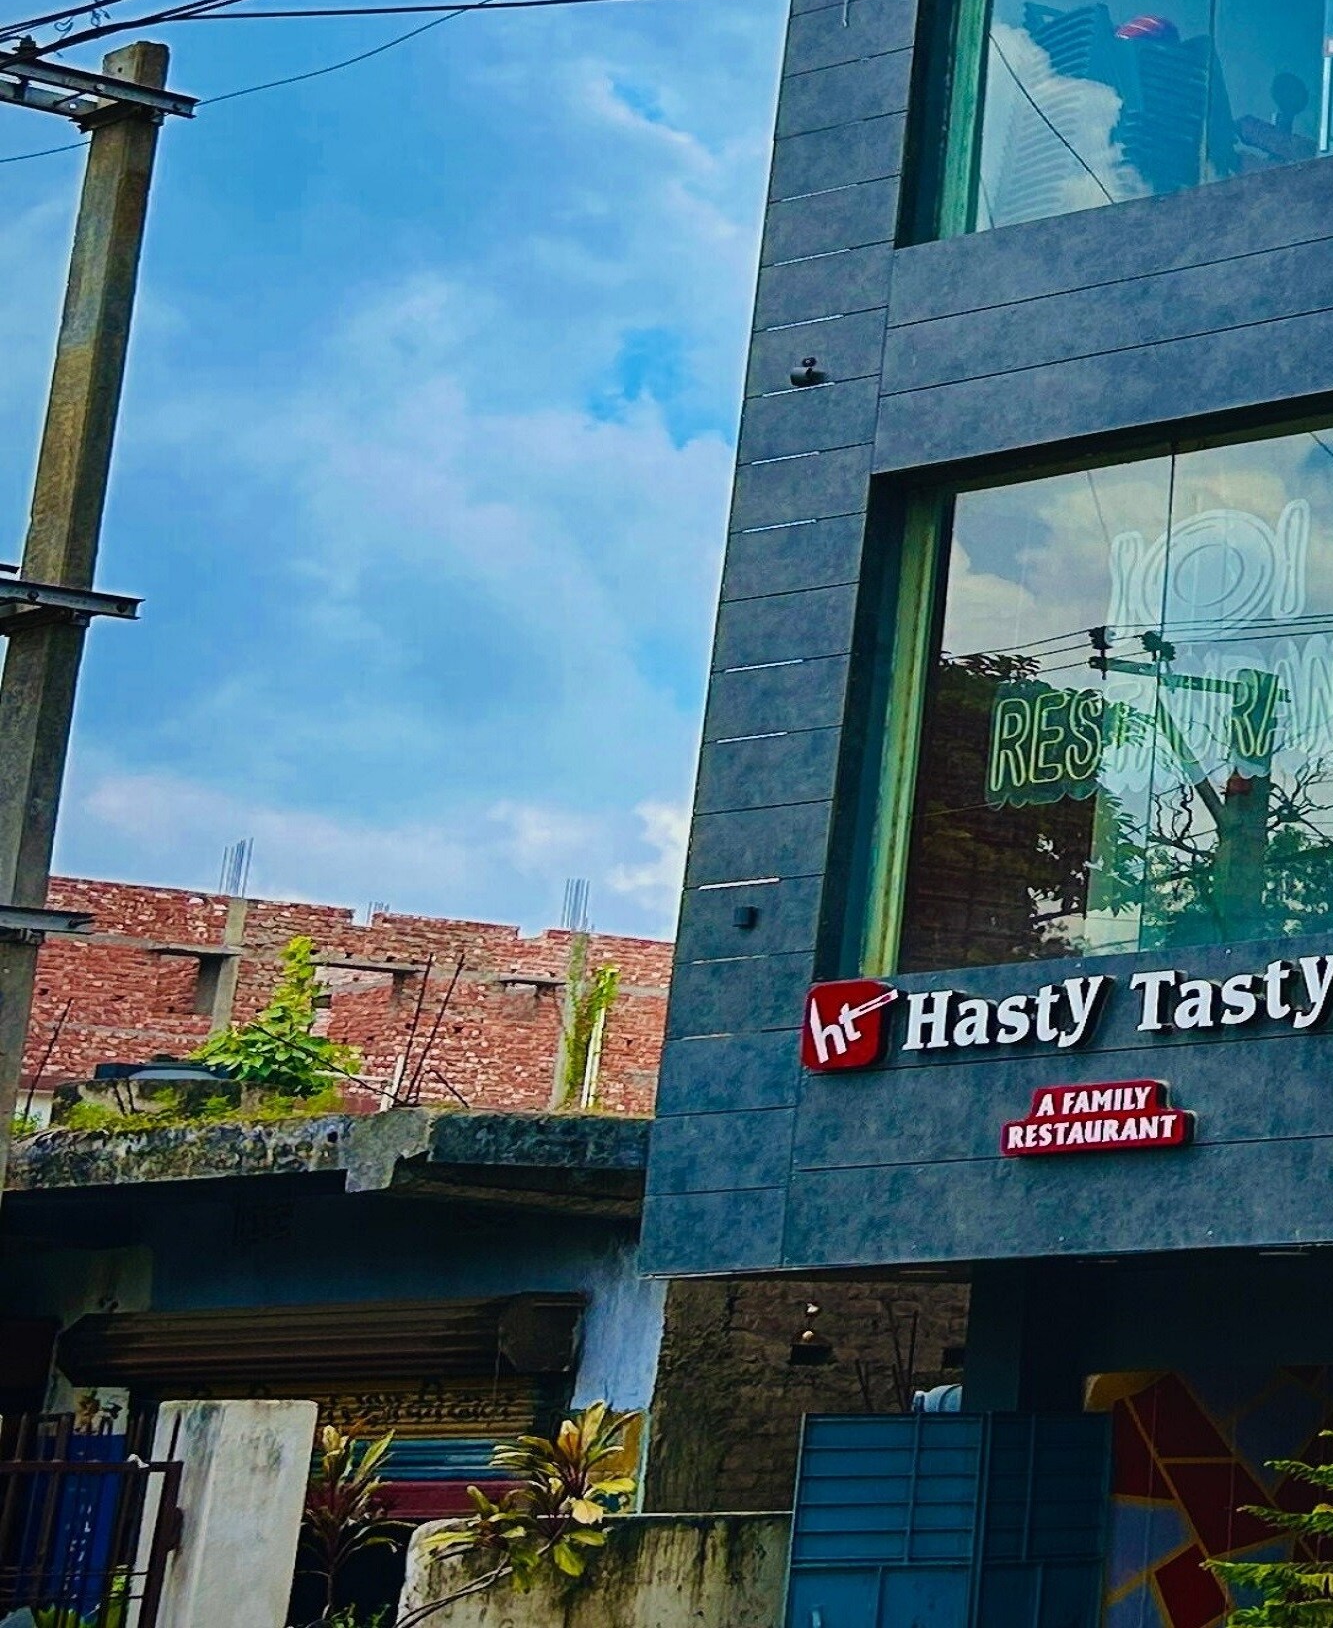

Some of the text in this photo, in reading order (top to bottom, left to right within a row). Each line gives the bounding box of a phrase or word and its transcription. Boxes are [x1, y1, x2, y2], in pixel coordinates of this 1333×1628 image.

[902, 974, 1104, 1051] Hasty
[1037, 1085, 1153, 1117] A FAMILY
[1006, 1114, 1178, 1150] RESTAURANT
